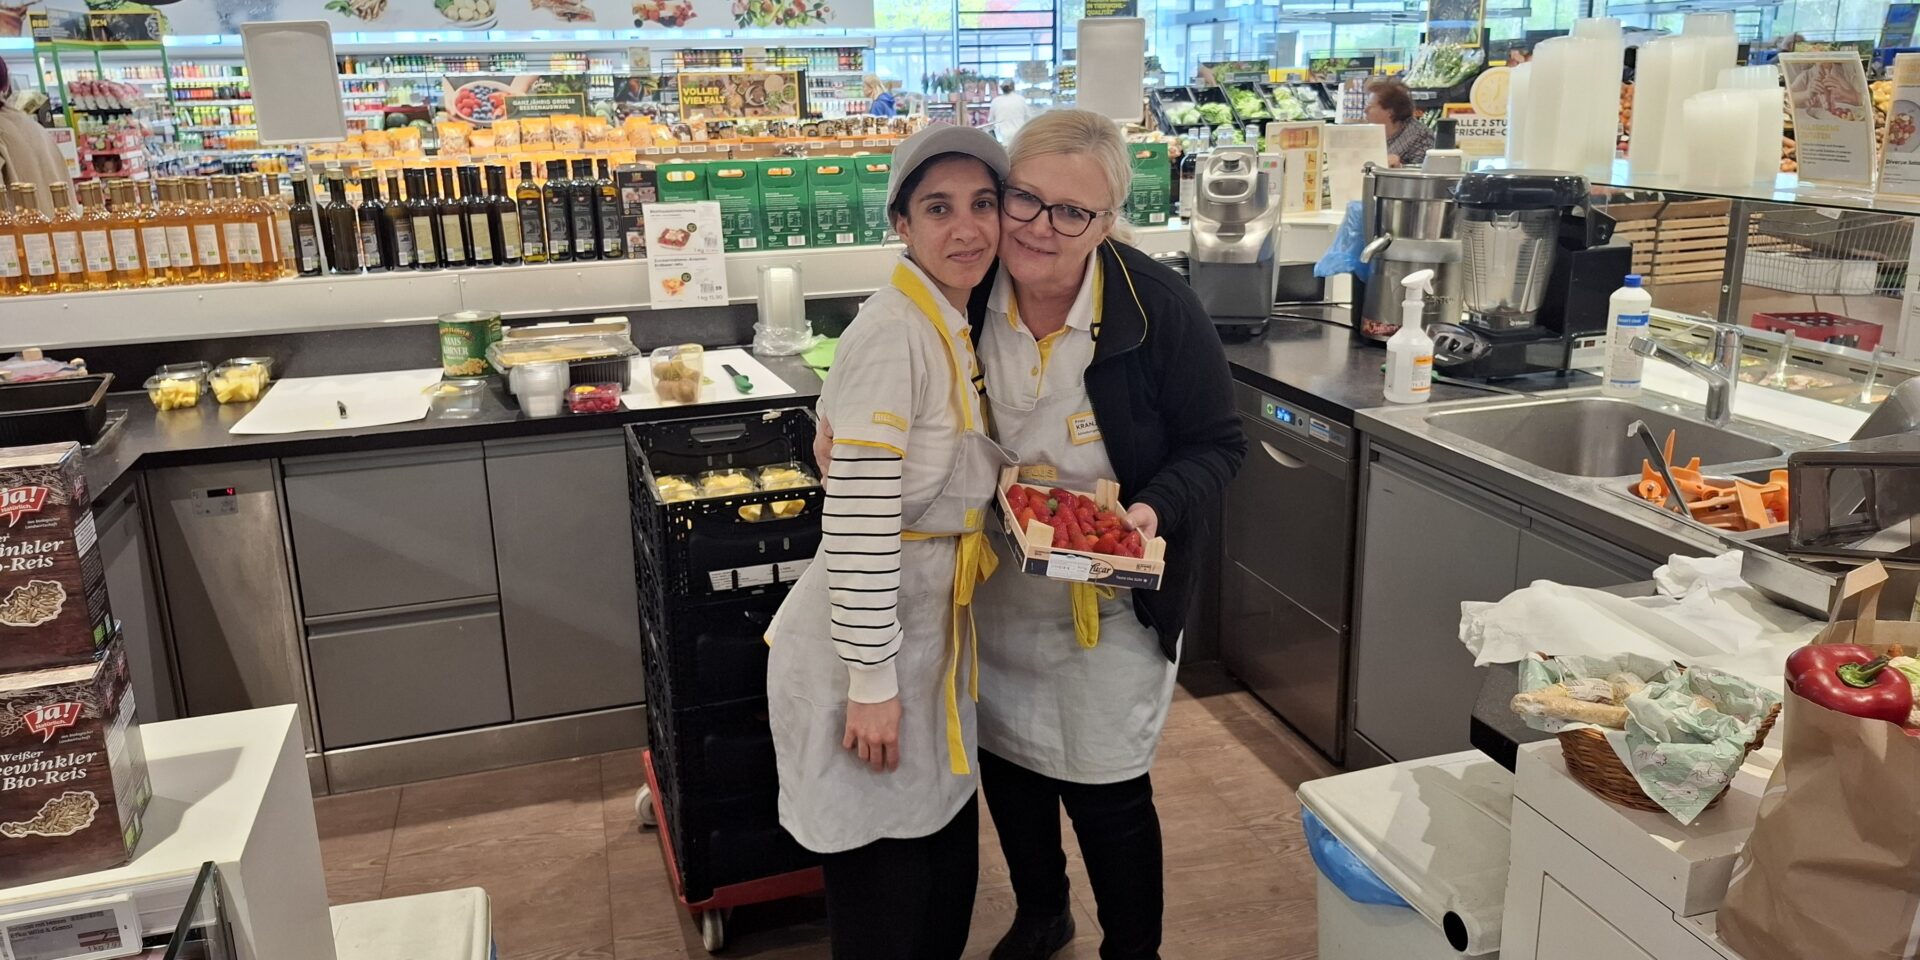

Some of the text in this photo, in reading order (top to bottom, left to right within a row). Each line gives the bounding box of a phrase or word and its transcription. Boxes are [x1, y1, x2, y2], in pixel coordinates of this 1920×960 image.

[682, 87, 720, 96] VOLLER
[512, 98, 551, 106] GANZJÄHRIG
[683, 96, 726, 105] VIELFALT
[1455, 119, 1508, 127] ALLE 2 STU
[1455, 128, 1507, 136] FRISCHE-C
[444, 336, 462, 346] MAIS
[1075, 422, 1096, 430] KRAN
[0, 486, 38, 507] ja!
[0, 540, 64, 557] inkler
[0, 554, 54, 571] -Reis
[35, 702, 72, 724] ja!
[0, 750, 44, 762] Weißer
[0, 752, 98, 777] ewinkler
[1, 767, 87, 791] Bio-Reis
